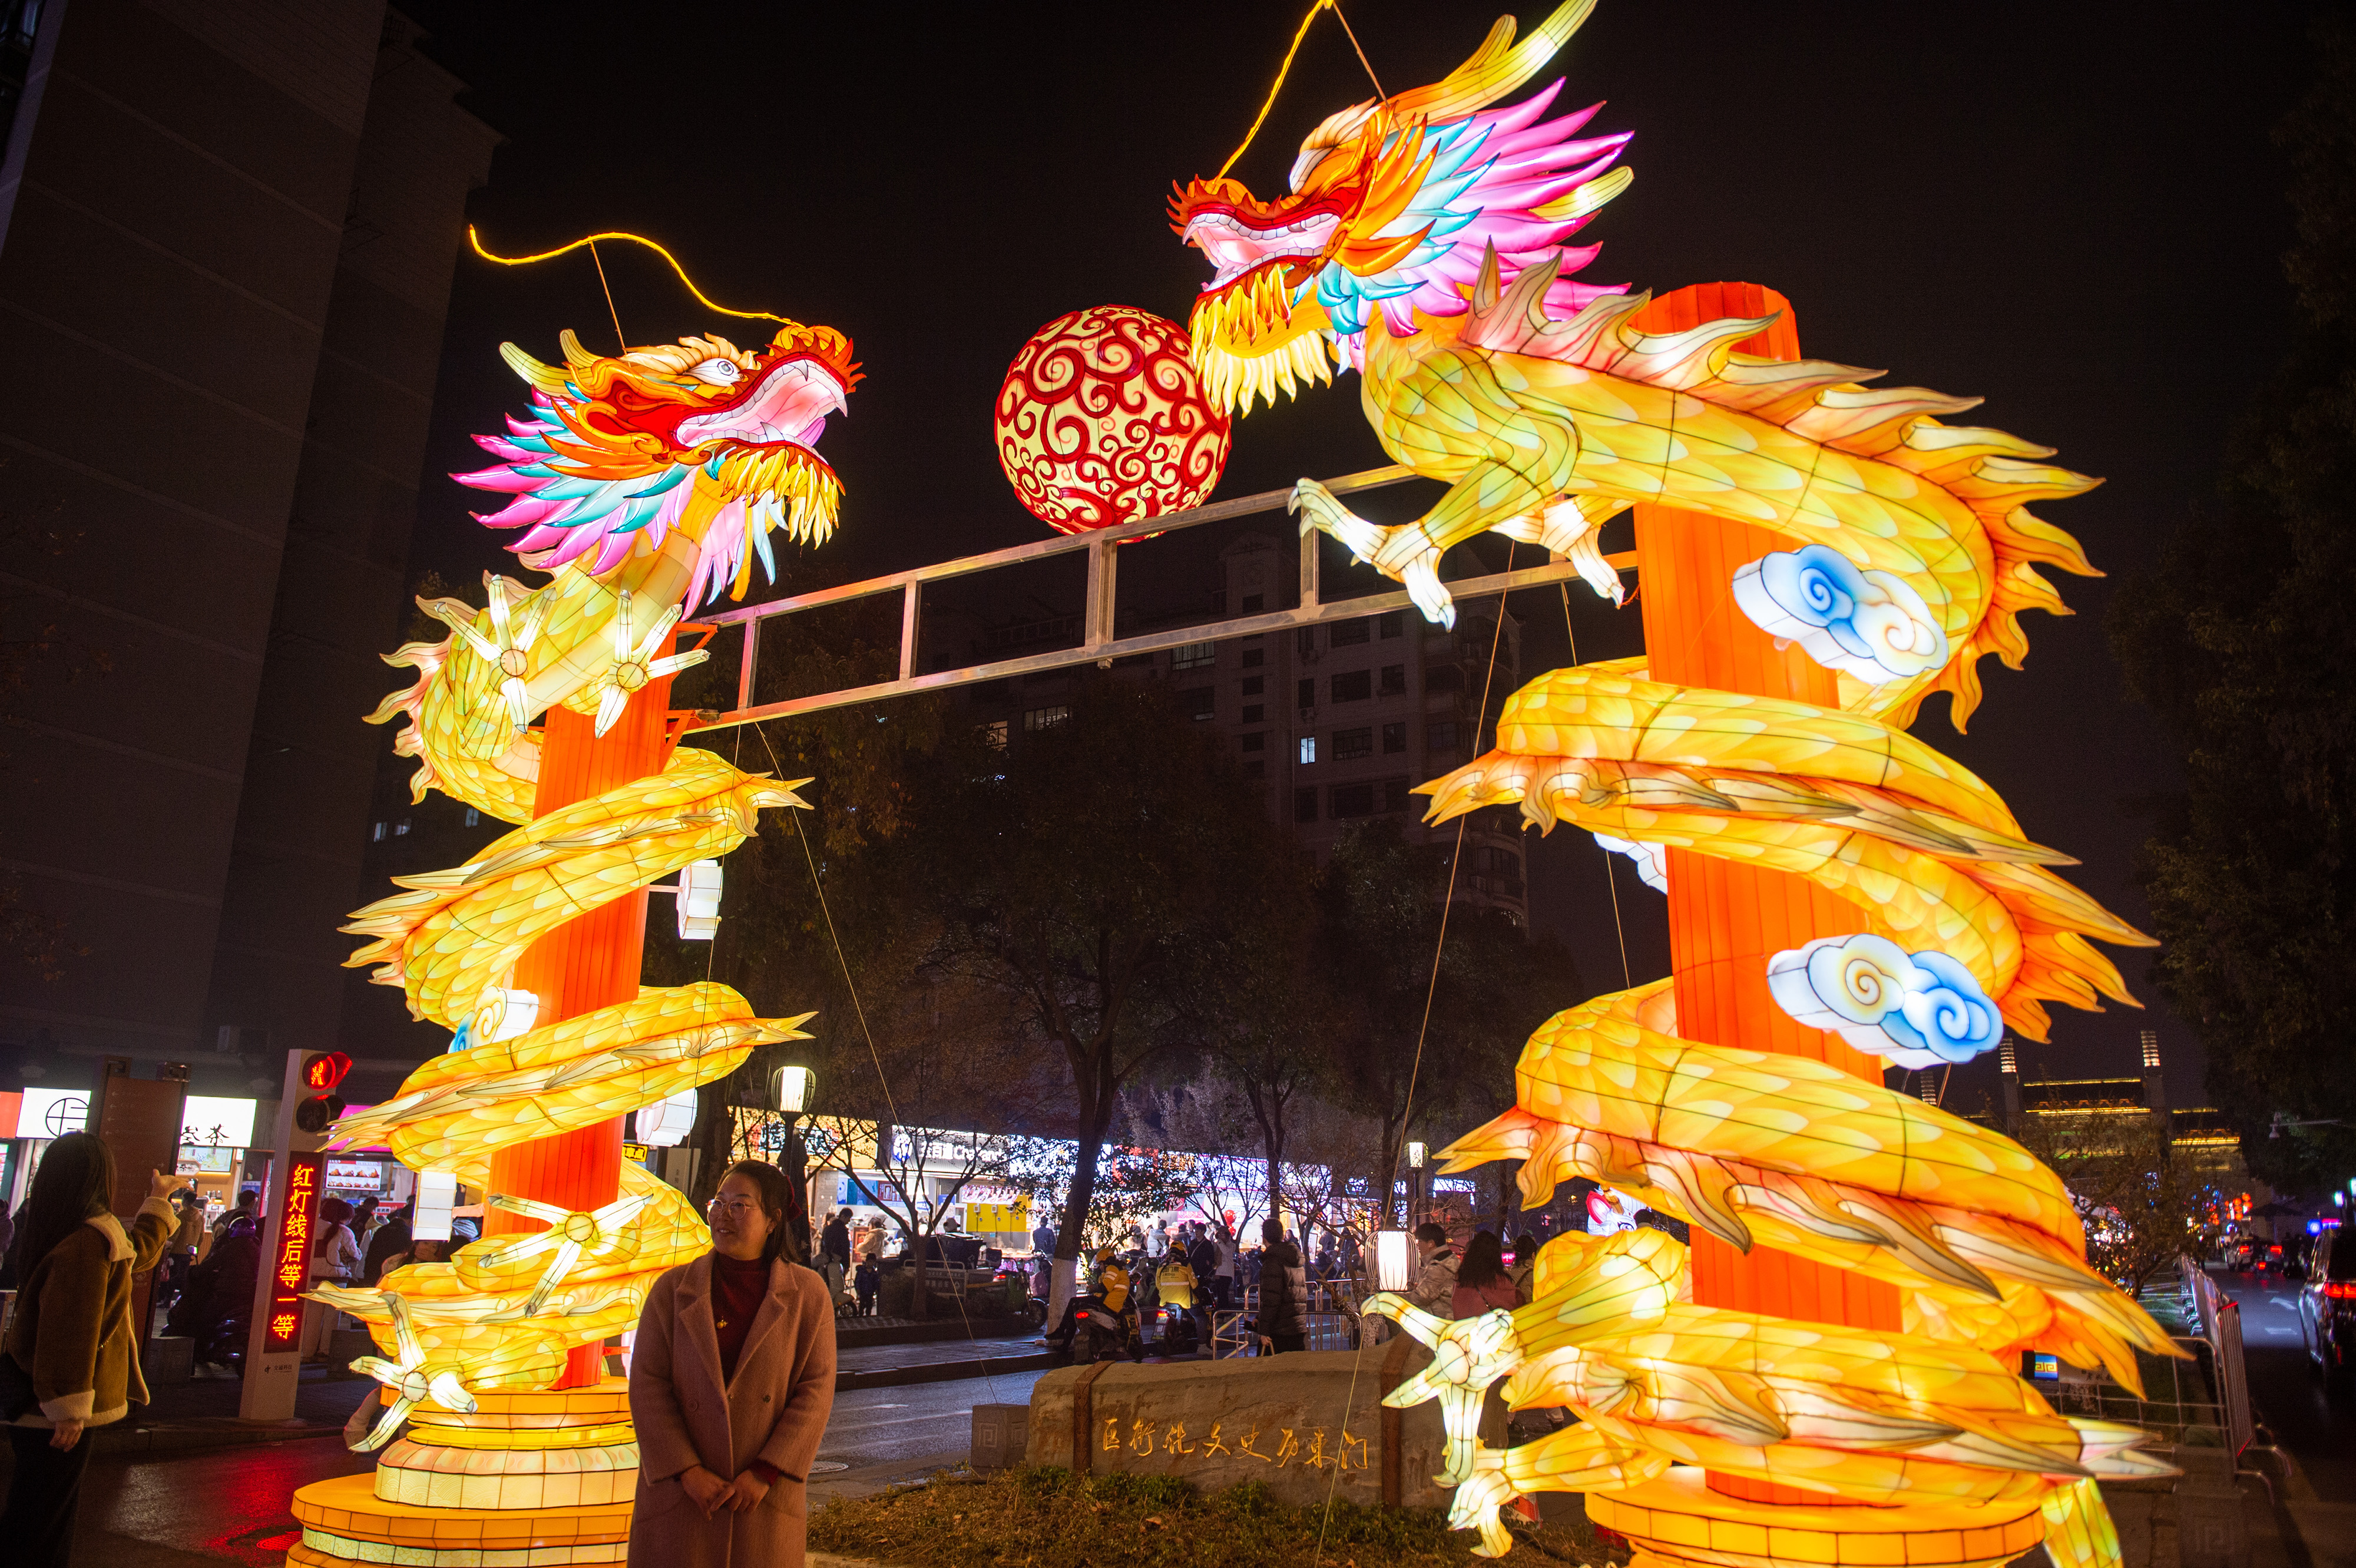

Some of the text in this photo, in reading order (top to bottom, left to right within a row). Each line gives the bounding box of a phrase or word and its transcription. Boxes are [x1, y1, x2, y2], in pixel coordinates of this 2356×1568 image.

[273, 1164, 313, 1339] 红灯线后等一等
